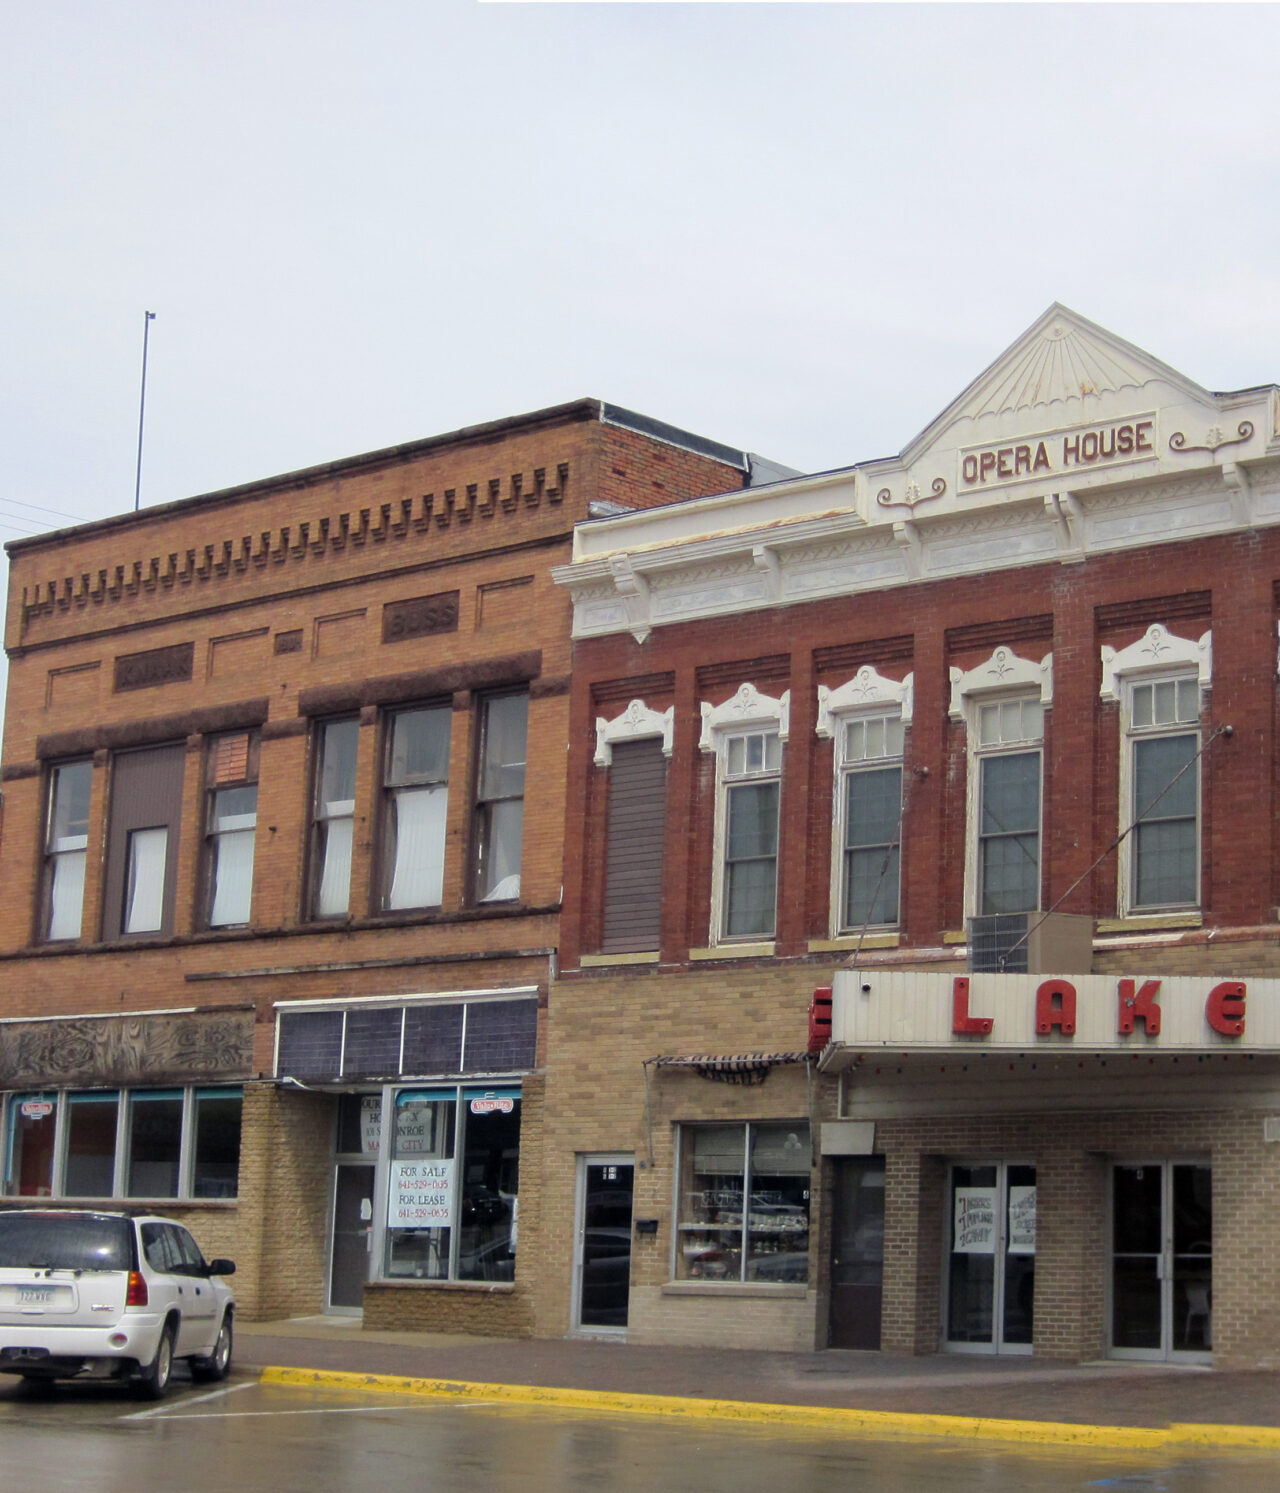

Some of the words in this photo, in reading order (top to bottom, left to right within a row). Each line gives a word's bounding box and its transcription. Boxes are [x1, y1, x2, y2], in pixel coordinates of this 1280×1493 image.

[962, 442, 1051, 482] OPERA
[1063, 421, 1154, 465] HOUSE
[951, 977, 1246, 1037] LAKE
[402, 1140, 424, 1151] CITY
[400, 1168, 417, 1177] FOR
[422, 1167, 446, 1177] SALE
[399, 1195, 414, 1205] FOR
[418, 1195, 445, 1205] LEASE
